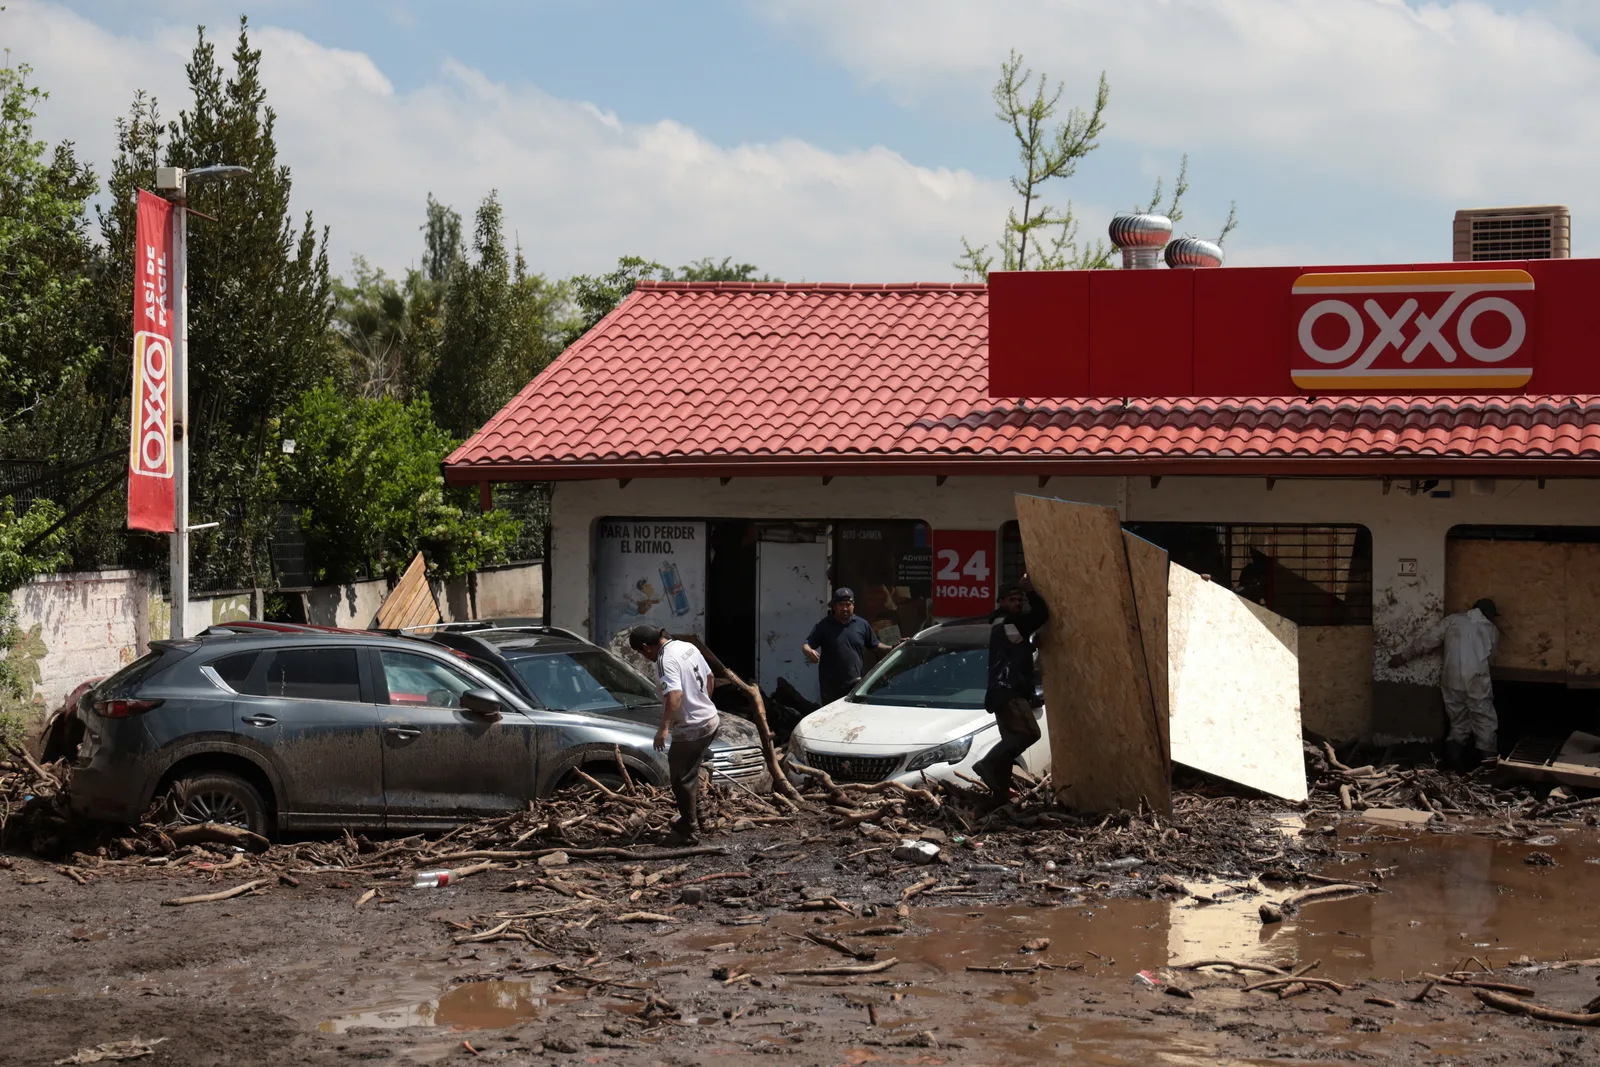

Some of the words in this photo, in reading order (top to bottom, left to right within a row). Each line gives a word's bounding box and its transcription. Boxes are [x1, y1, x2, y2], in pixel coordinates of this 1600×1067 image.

[146, 245, 155, 275] DE
[143, 280, 155, 322] ASÍ
[156, 252, 167, 327] FÁCIL
[1297, 290, 1527, 369] OXXO
[142, 340, 166, 469] OXXO
[601, 524, 630, 539] PARA
[633, 525, 651, 539] NO
[654, 525, 695, 540] PERDER
[620, 541, 632, 554] EL
[635, 541, 674, 555] RITMO.
[936, 549, 990, 581] 24
[936, 585, 990, 599] HORAS
